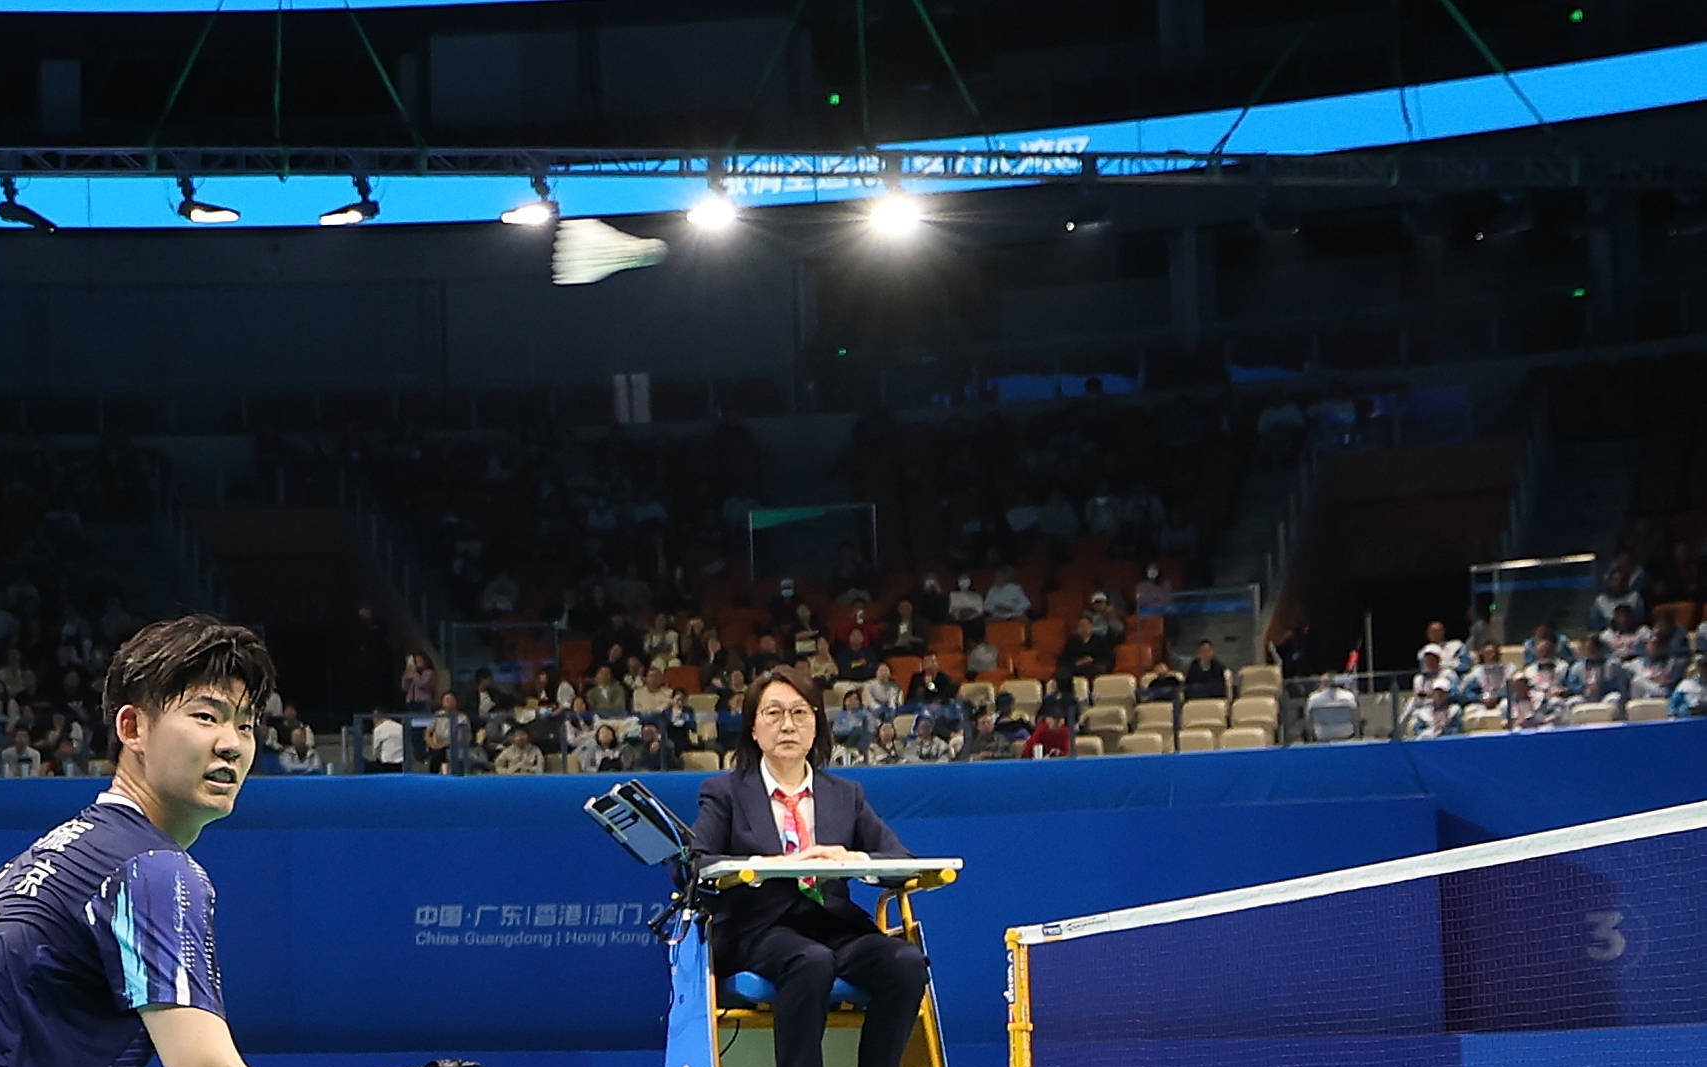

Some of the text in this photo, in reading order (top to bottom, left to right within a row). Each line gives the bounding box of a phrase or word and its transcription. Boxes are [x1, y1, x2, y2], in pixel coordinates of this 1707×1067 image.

[565, 931, 607, 947] Hong
[610, 931, 651, 947] Kong
[1590, 910, 1627, 961] 3
